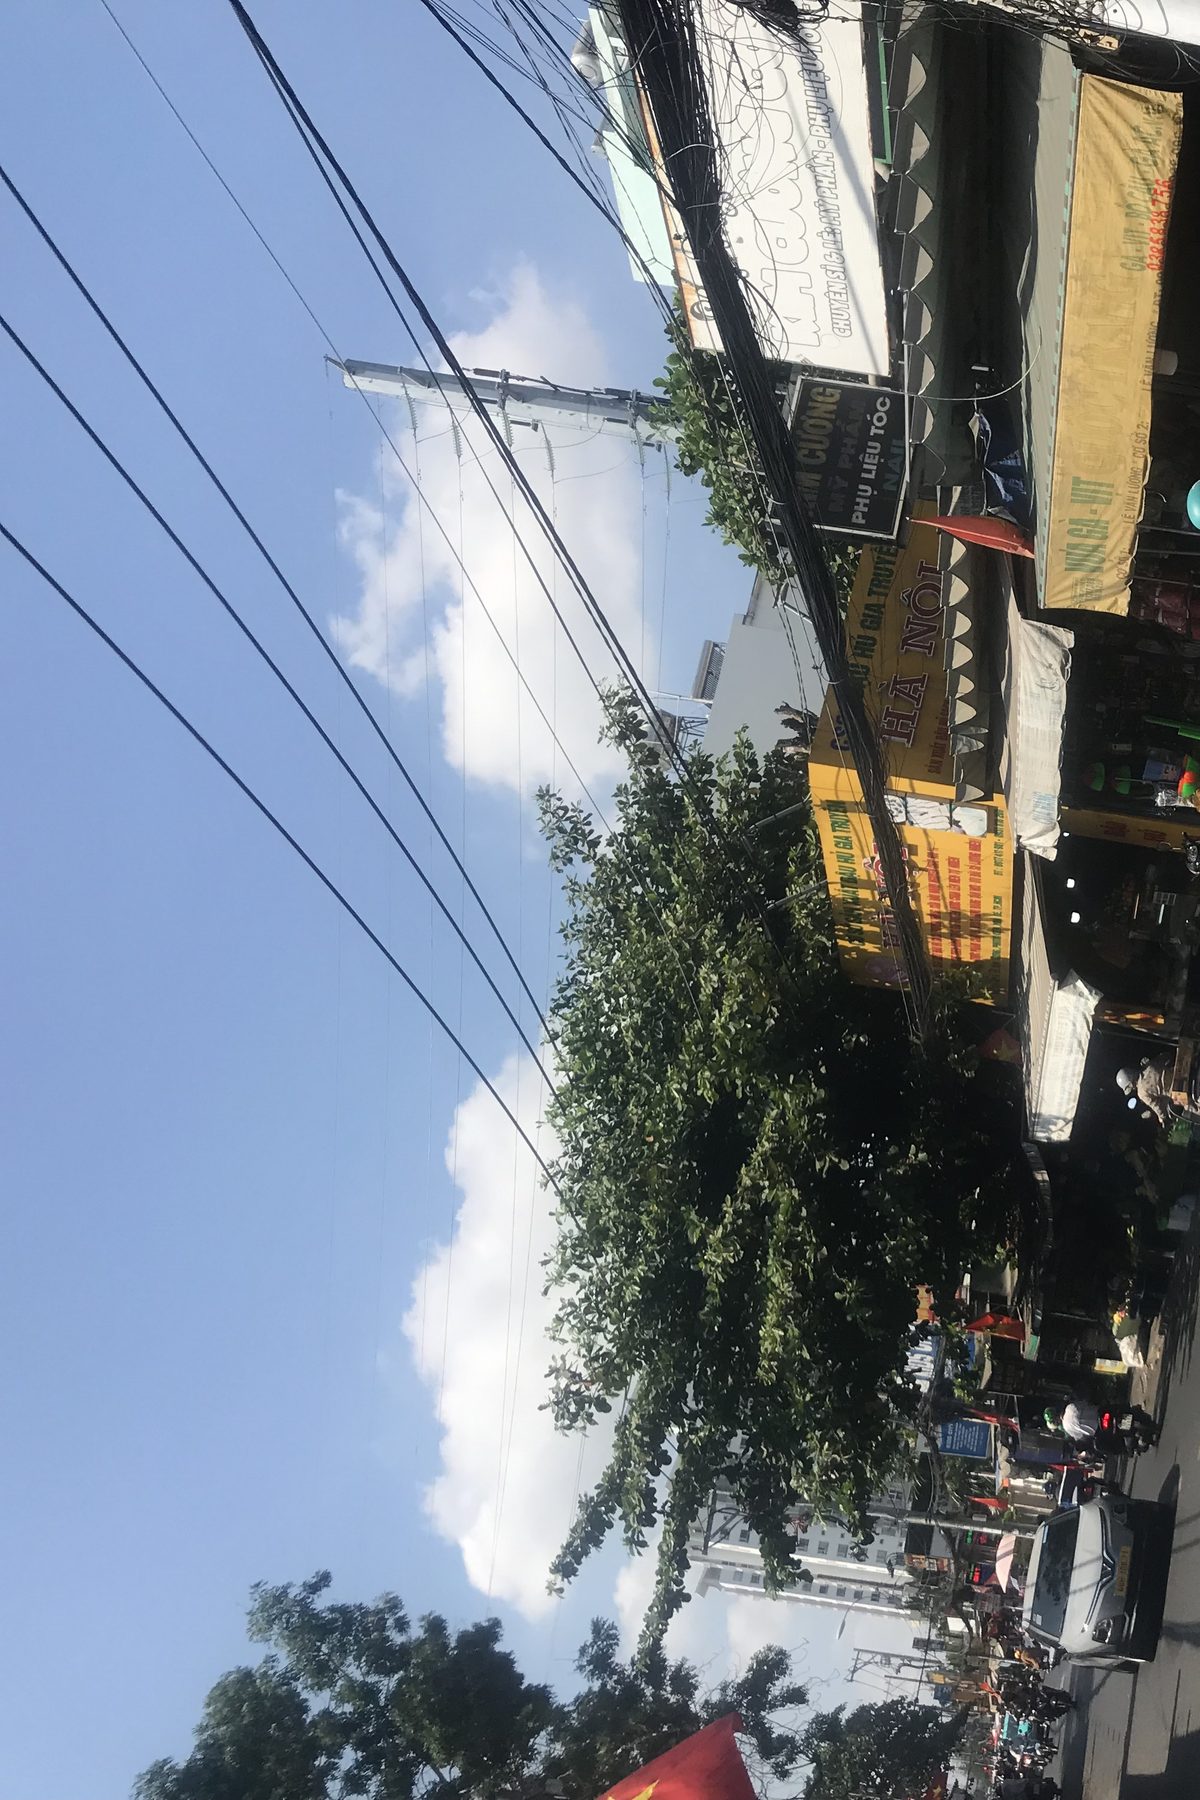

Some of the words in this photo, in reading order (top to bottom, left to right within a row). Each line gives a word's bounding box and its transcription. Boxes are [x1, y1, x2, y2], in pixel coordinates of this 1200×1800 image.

[797, 57, 831, 99] LIỆU
[805, 100, 834, 139] PHỤ
[824, 280, 852, 337] CHUYÊN
[865, 396, 892, 436] TÓC
[1130, 432, 1148, 445] SỞ
[1130, 445, 1146, 459] CƠ
[858, 440, 885, 479] LIỆU
[1070, 476, 1122, 505] VỊT
[1126, 466, 1143, 495] LƯƠNG
[851, 484, 878, 525] PHỤ
[1121, 513, 1136, 525] LÊ
[1058, 517, 1110, 539] GÀ
[865, 545, 899, 597] TRUYỀ
[859, 603, 885, 631] GIA
[877, 672, 929, 747] HÀ
[831, 835, 855, 850] GIA
